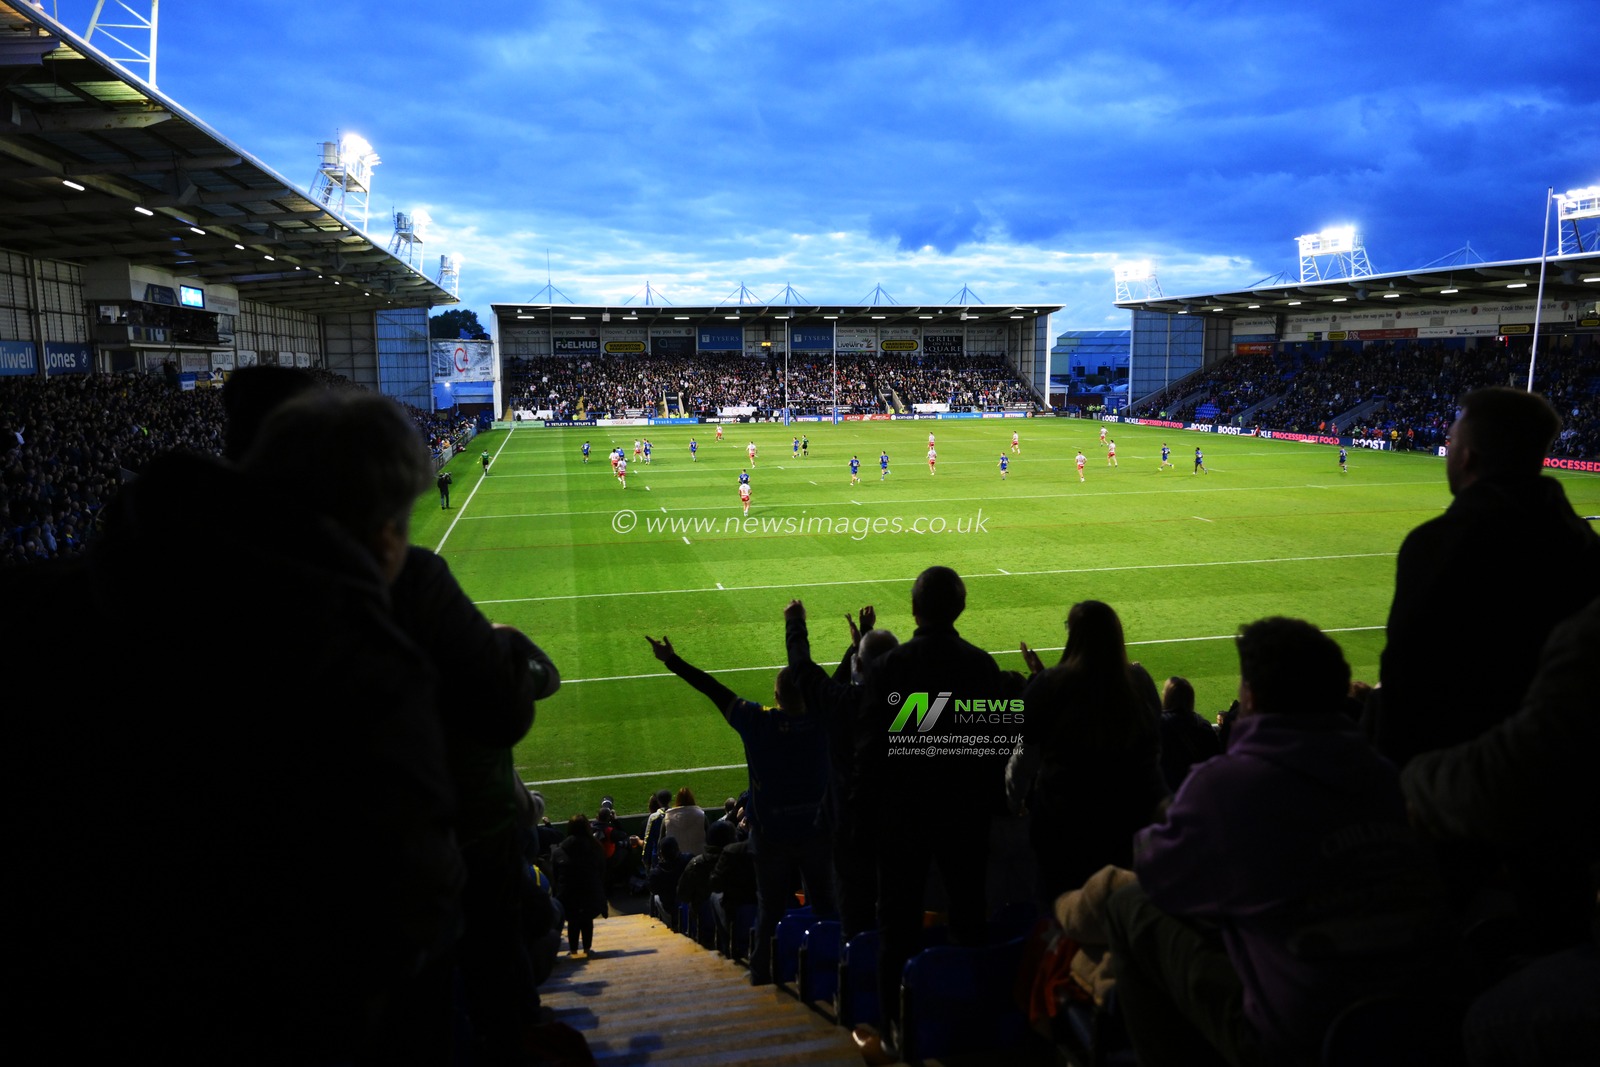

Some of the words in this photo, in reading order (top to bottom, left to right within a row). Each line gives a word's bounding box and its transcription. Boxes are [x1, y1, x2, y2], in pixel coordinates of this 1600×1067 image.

[45, 347, 76, 370] Jones
[1191, 423, 1212, 432] BOOST
[1218, 426, 1241, 435] BOOST
[1272, 431, 1308, 441] PROCESSED
[1320, 437, 1340, 445] FOOD
[1543, 457, 1600, 472] ROCESSED
